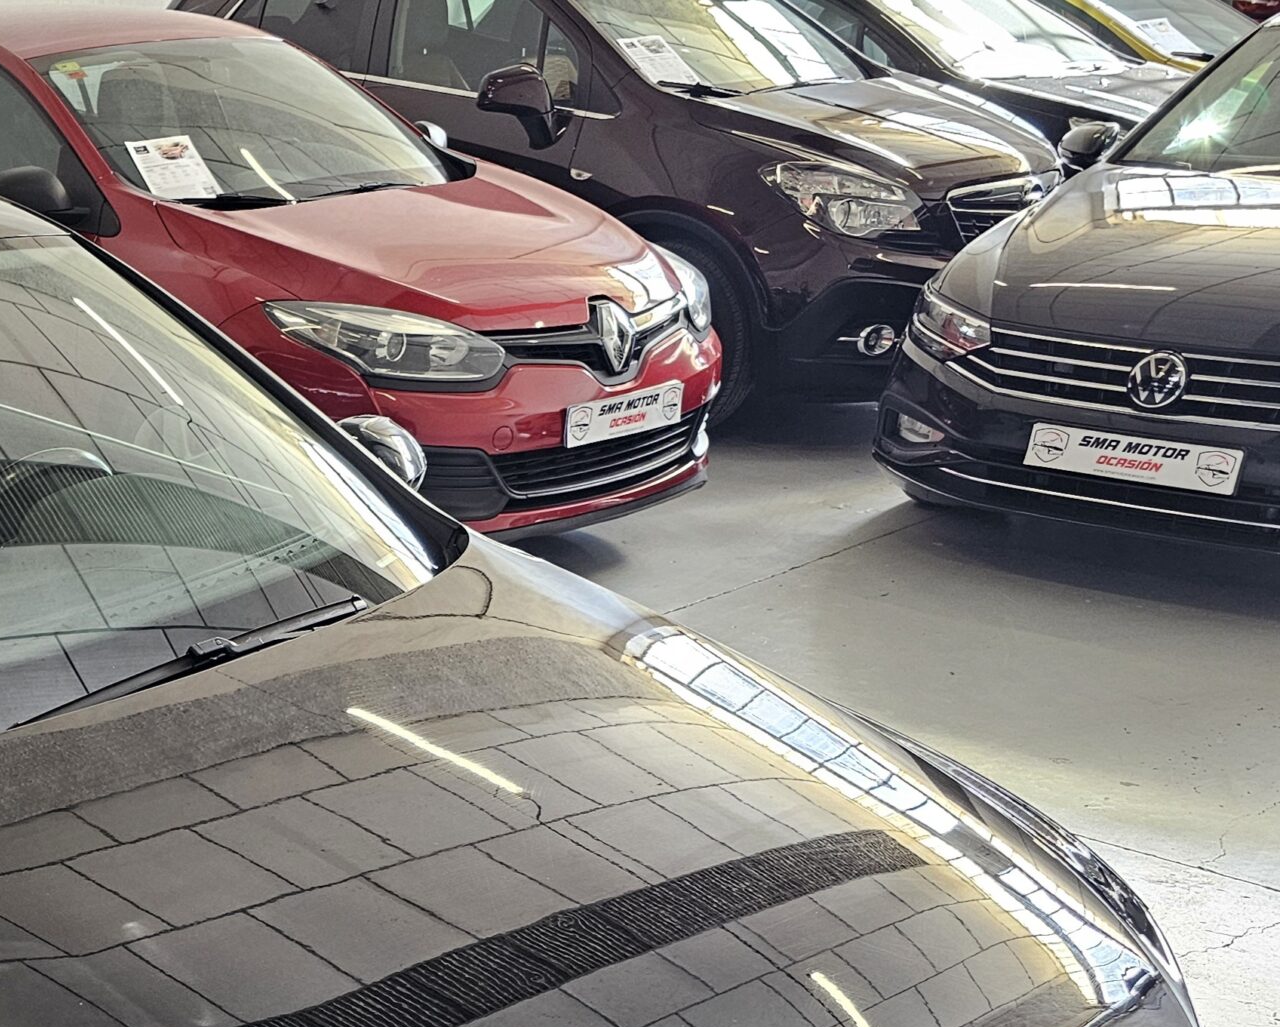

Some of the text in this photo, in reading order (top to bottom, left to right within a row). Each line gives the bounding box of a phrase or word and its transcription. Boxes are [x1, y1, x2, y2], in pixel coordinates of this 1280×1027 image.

[598, 393, 660, 416] SMA MOTOR
[1078, 435, 1191, 460] SMA MOTOR
[1096, 455, 1163, 472] OCASIÓN
